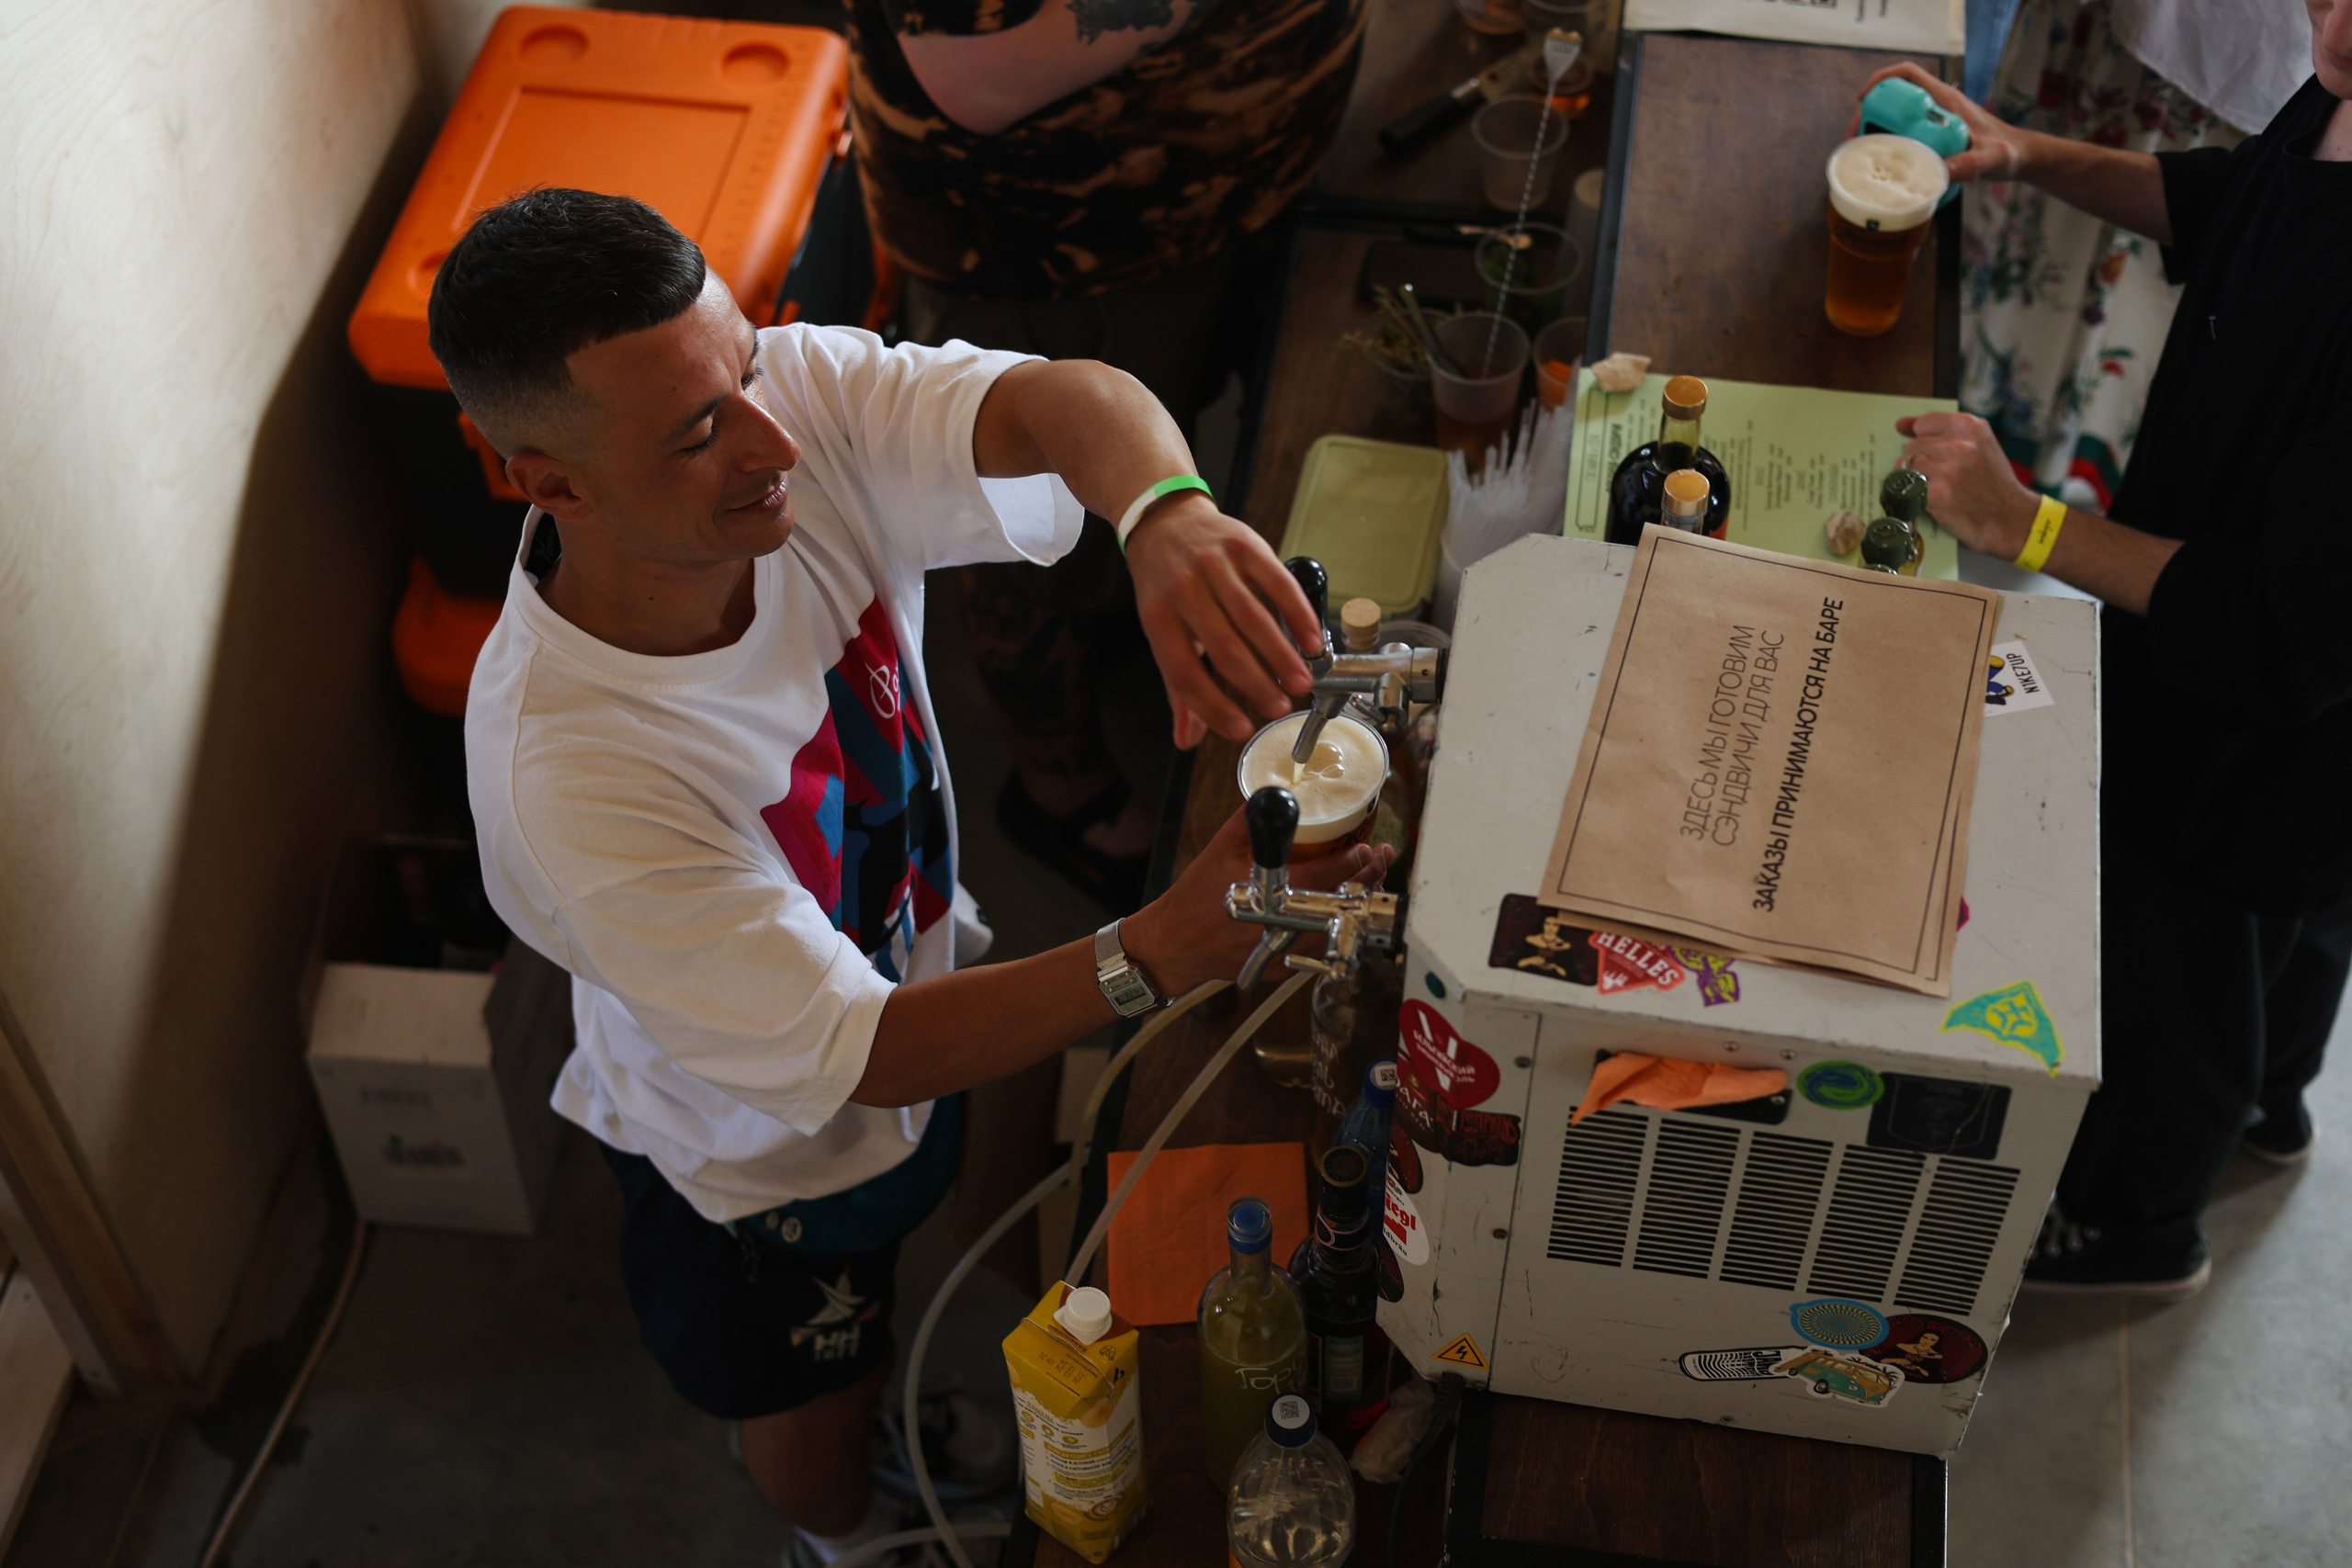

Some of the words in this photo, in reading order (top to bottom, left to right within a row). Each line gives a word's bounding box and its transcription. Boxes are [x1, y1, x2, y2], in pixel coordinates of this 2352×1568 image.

[1815, 597, 1844, 644] БАРЕ
[1753, 630, 1784, 672] ВАС
[1808, 648, 1833, 673] НА
[1708, 625, 1755, 727] ГОТОВИМ
[1743, 674, 1773, 722] ДЛЯ
[1697, 729, 1729, 770] МЫ
[1772, 674, 1826, 829] ПРИНИМАЮТСЯ
[1679, 772, 1718, 841] ЗДЕСЬ
[1711, 721, 1762, 846] СЭНДВИЧИ
[1752, 830, 1791, 912] ЗАКАЗЫ
[1597, 932, 1679, 986] HELLES
[1385, 1192, 1416, 1231] iegl
[1026, 1400, 1056, 1425] BANANA
